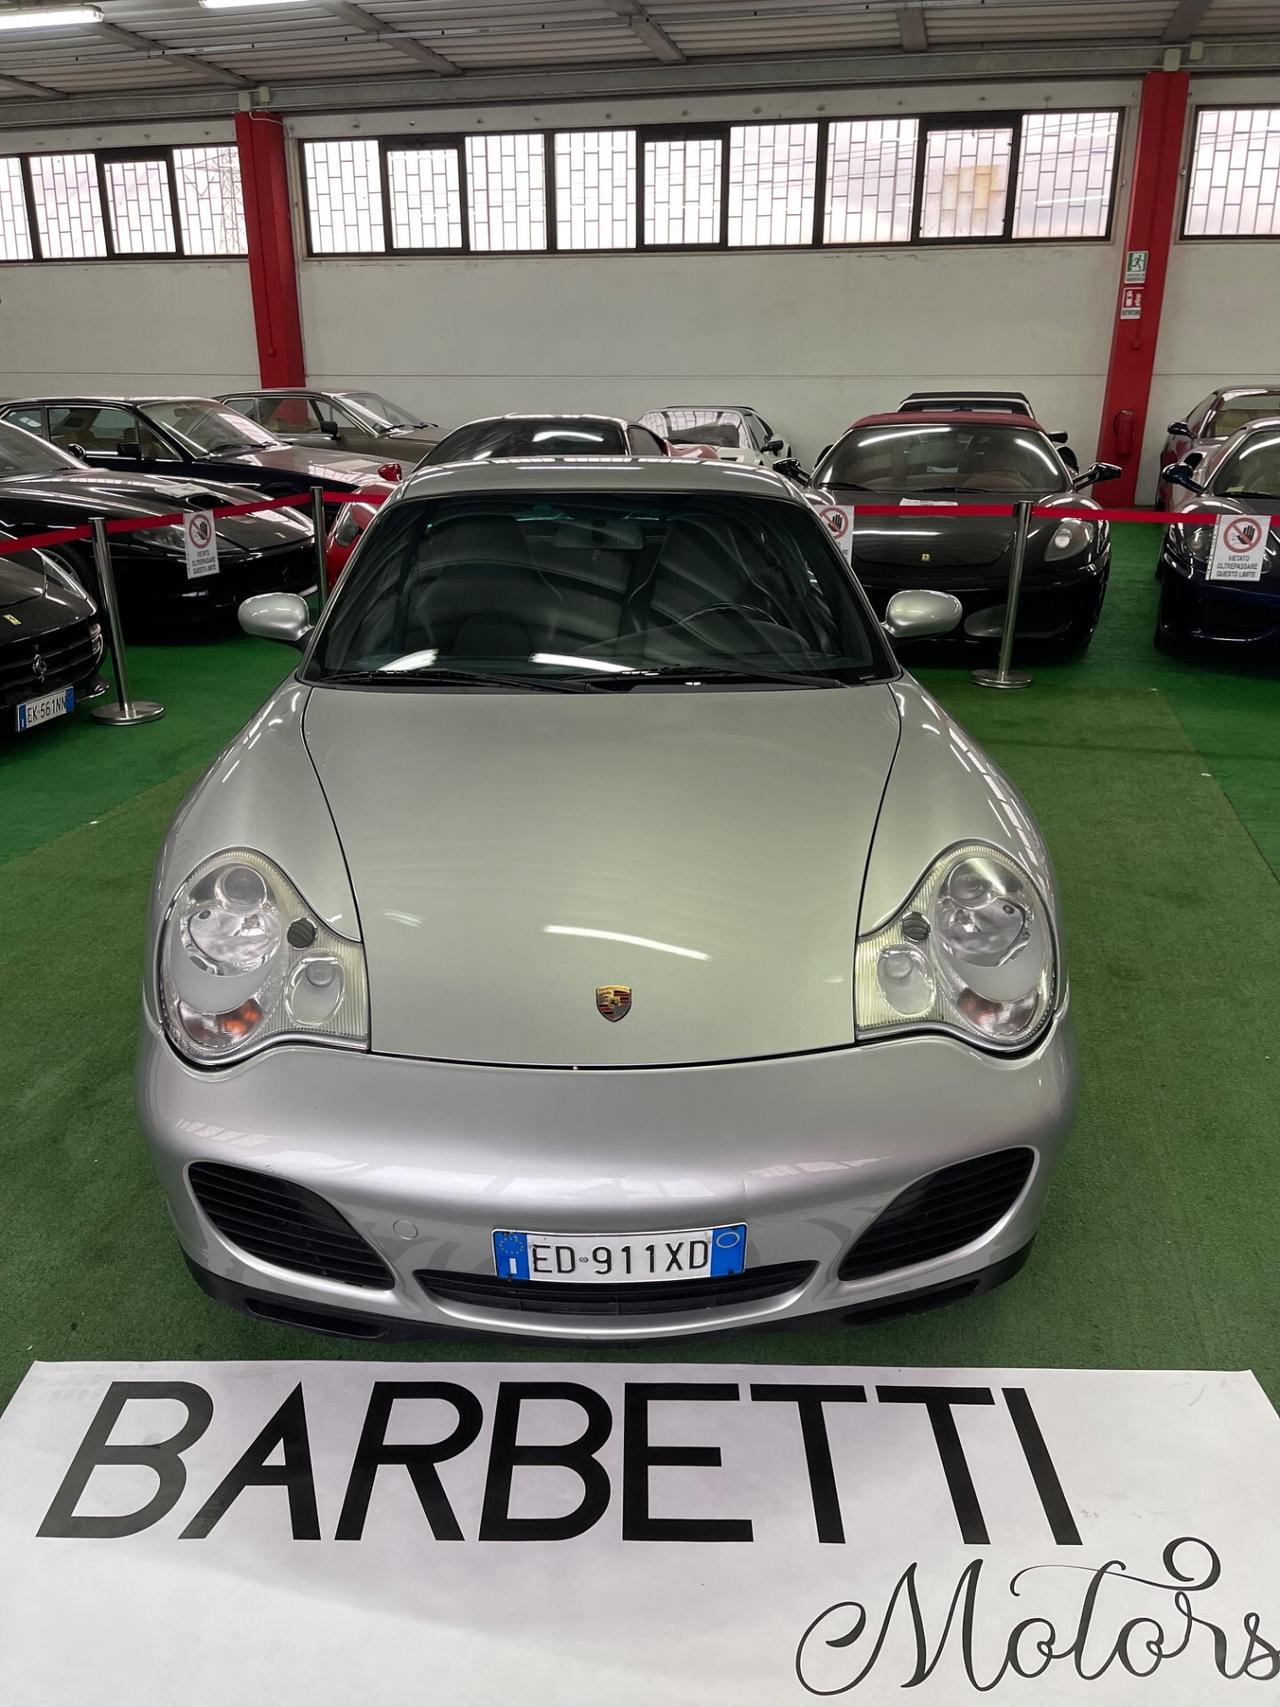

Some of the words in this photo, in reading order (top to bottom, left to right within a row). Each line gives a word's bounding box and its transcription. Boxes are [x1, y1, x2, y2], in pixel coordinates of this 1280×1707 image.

[1216, 562, 1258, 570] OLTREPASSARE
[36, 1381, 1083, 1545] BARBETTI
[796, 1537, 1280, 1696] Motors
